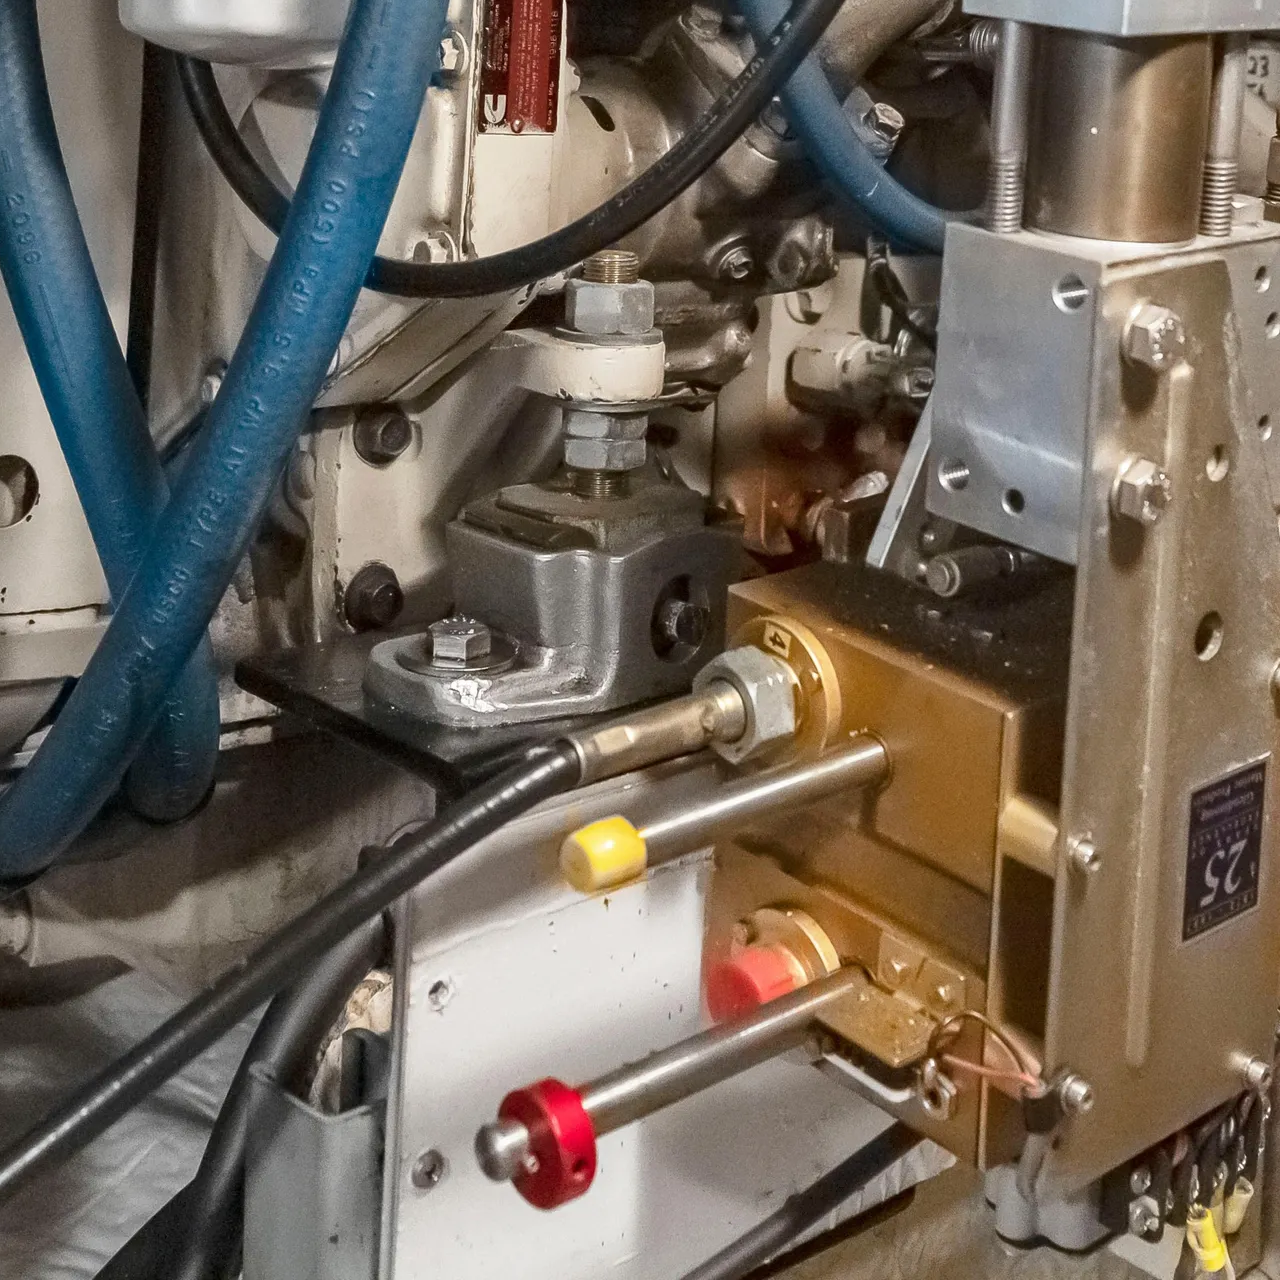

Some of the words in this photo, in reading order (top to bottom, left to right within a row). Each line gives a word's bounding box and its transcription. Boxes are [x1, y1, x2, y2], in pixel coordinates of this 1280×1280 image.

[187, 488, 228, 550] TYPE
[311, 177, 348, 246] (500
[1200, 838, 1248, 908] 25
